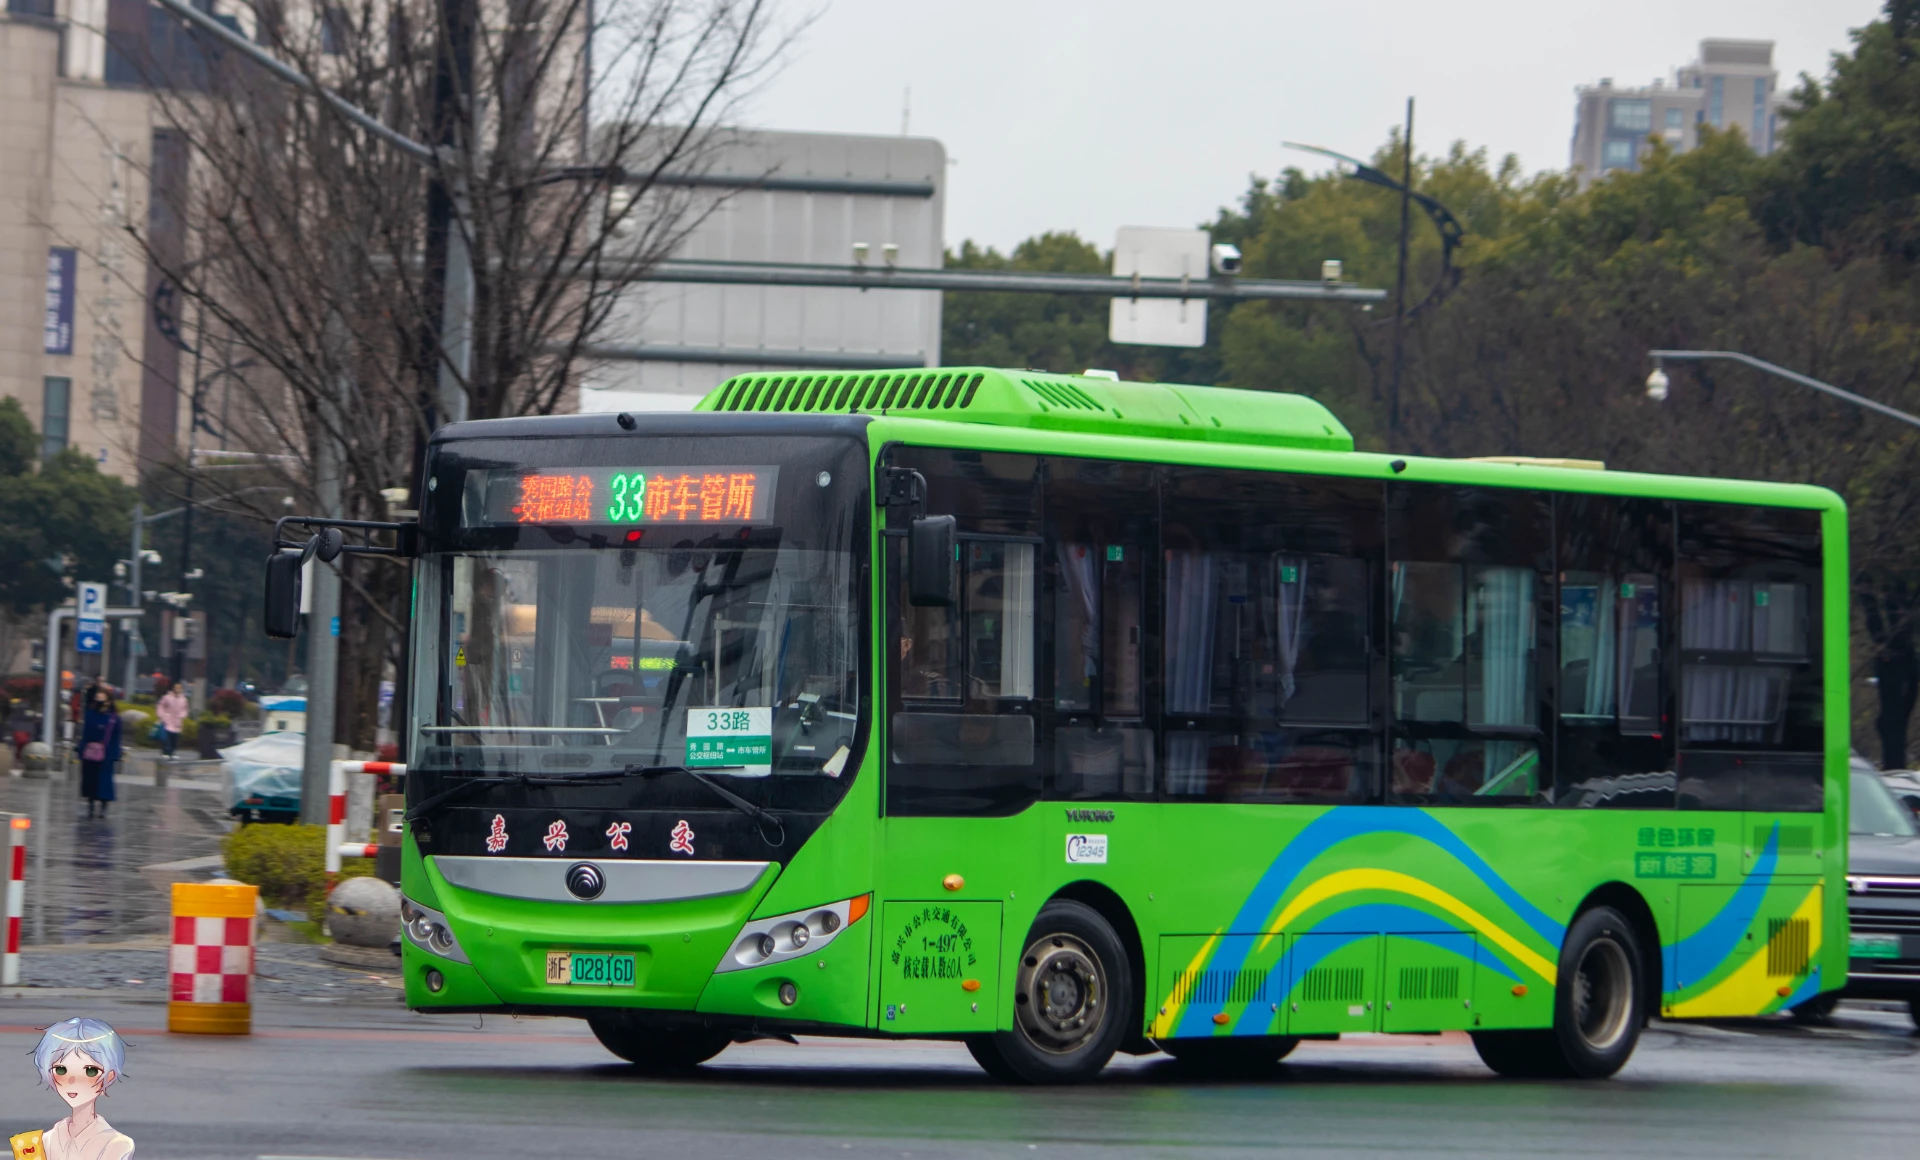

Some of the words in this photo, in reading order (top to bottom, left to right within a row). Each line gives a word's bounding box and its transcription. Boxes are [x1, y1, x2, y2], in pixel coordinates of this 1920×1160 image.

[608, 472, 646, 522] 33
[647, 472, 756, 520] 市车管所
[84, 588, 99, 612] P
[707, 711, 750, 731] 33路
[737, 746, 766, 755] 市车管所
[1065, 809, 1115, 823] YUTONG
[486, 813, 695, 855] 嘉兴公交
[1638, 827, 1715, 847] 绿色环保
[1076, 845, 1105, 858] 12345
[1639, 856, 1713, 875] 新能源
[891, 906, 977, 967] 嘉兴市公共交通有限公司
[922, 934, 958, 953] 1-497
[903, 956, 963, 979] 核定载人数60人
